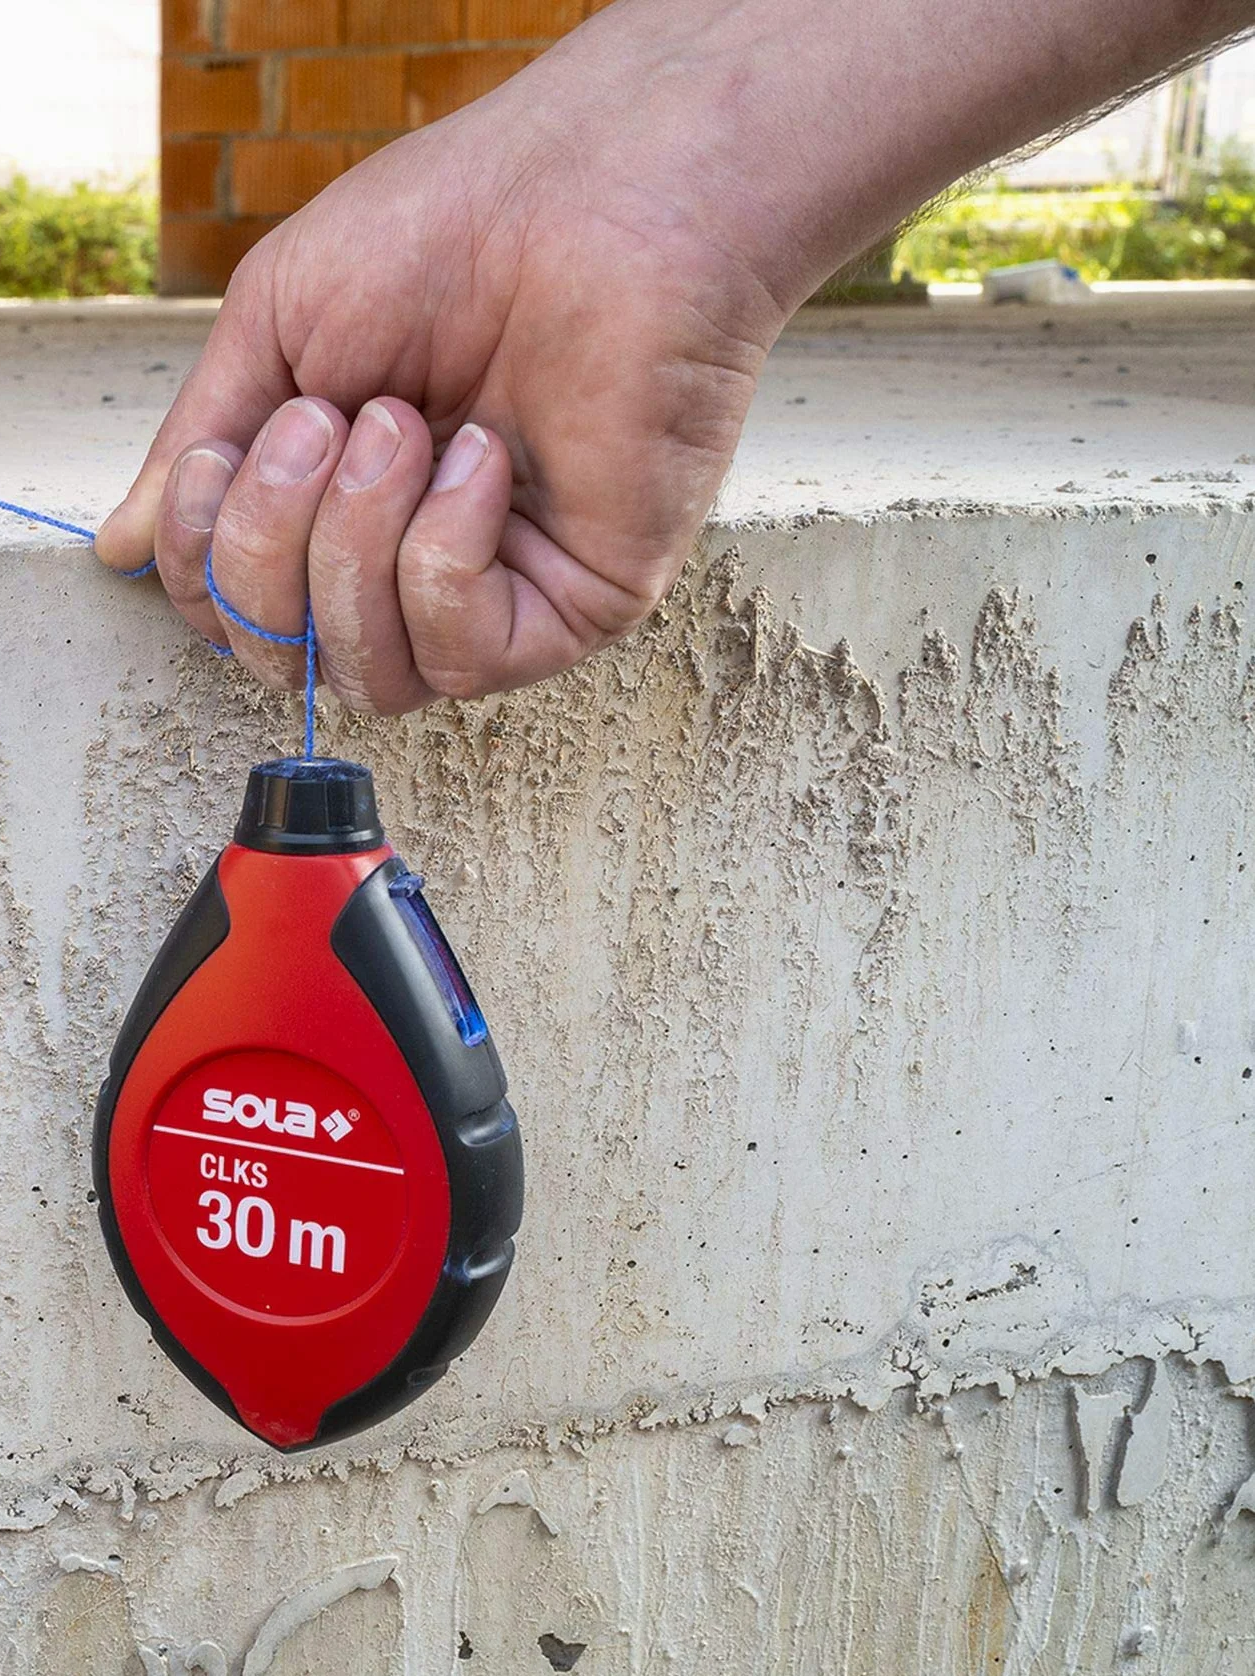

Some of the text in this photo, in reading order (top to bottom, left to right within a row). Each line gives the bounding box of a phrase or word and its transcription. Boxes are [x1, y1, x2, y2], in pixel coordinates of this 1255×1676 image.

[199, 1152, 268, 1188] CLKS
[196, 1189, 346, 1274] 30 m
